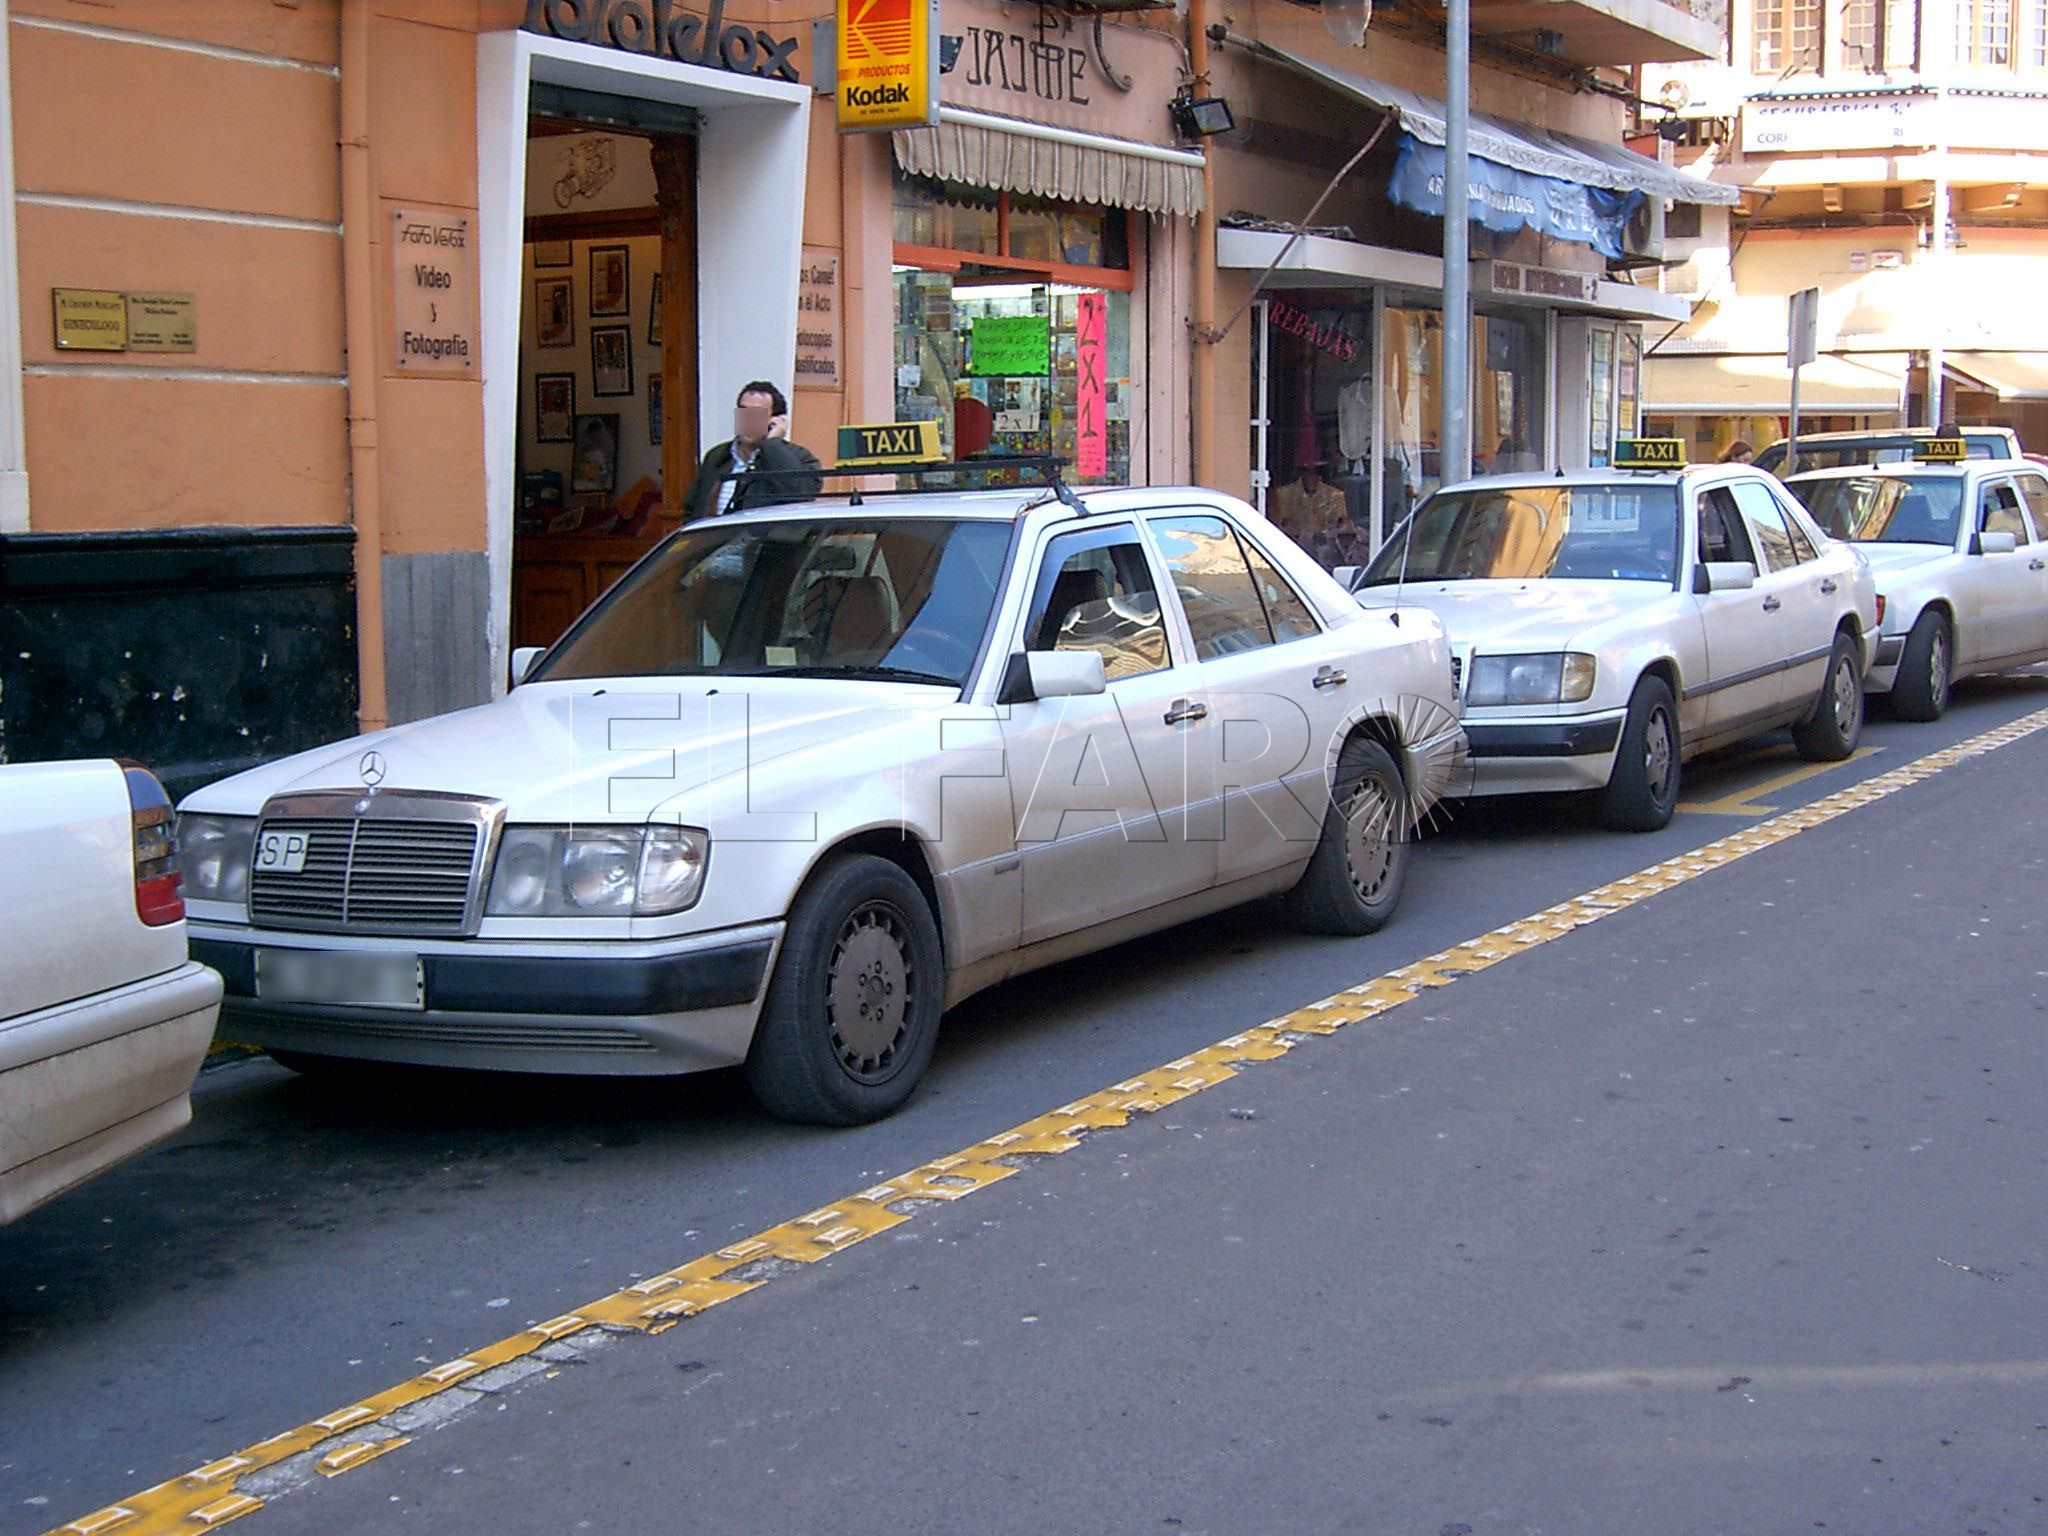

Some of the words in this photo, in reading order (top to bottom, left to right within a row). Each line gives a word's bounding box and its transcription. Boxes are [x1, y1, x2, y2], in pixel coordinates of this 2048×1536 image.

[858, 64, 910, 78] PRODUCTOS
[847, 83, 909, 106] Kodak
[415, 264, 452, 289] Video
[430, 301, 437, 323] y
[862, 429, 916, 454] TAXI
[1634, 443, 1674, 459] TAXI
[1927, 442, 1956, 454] TAXI
